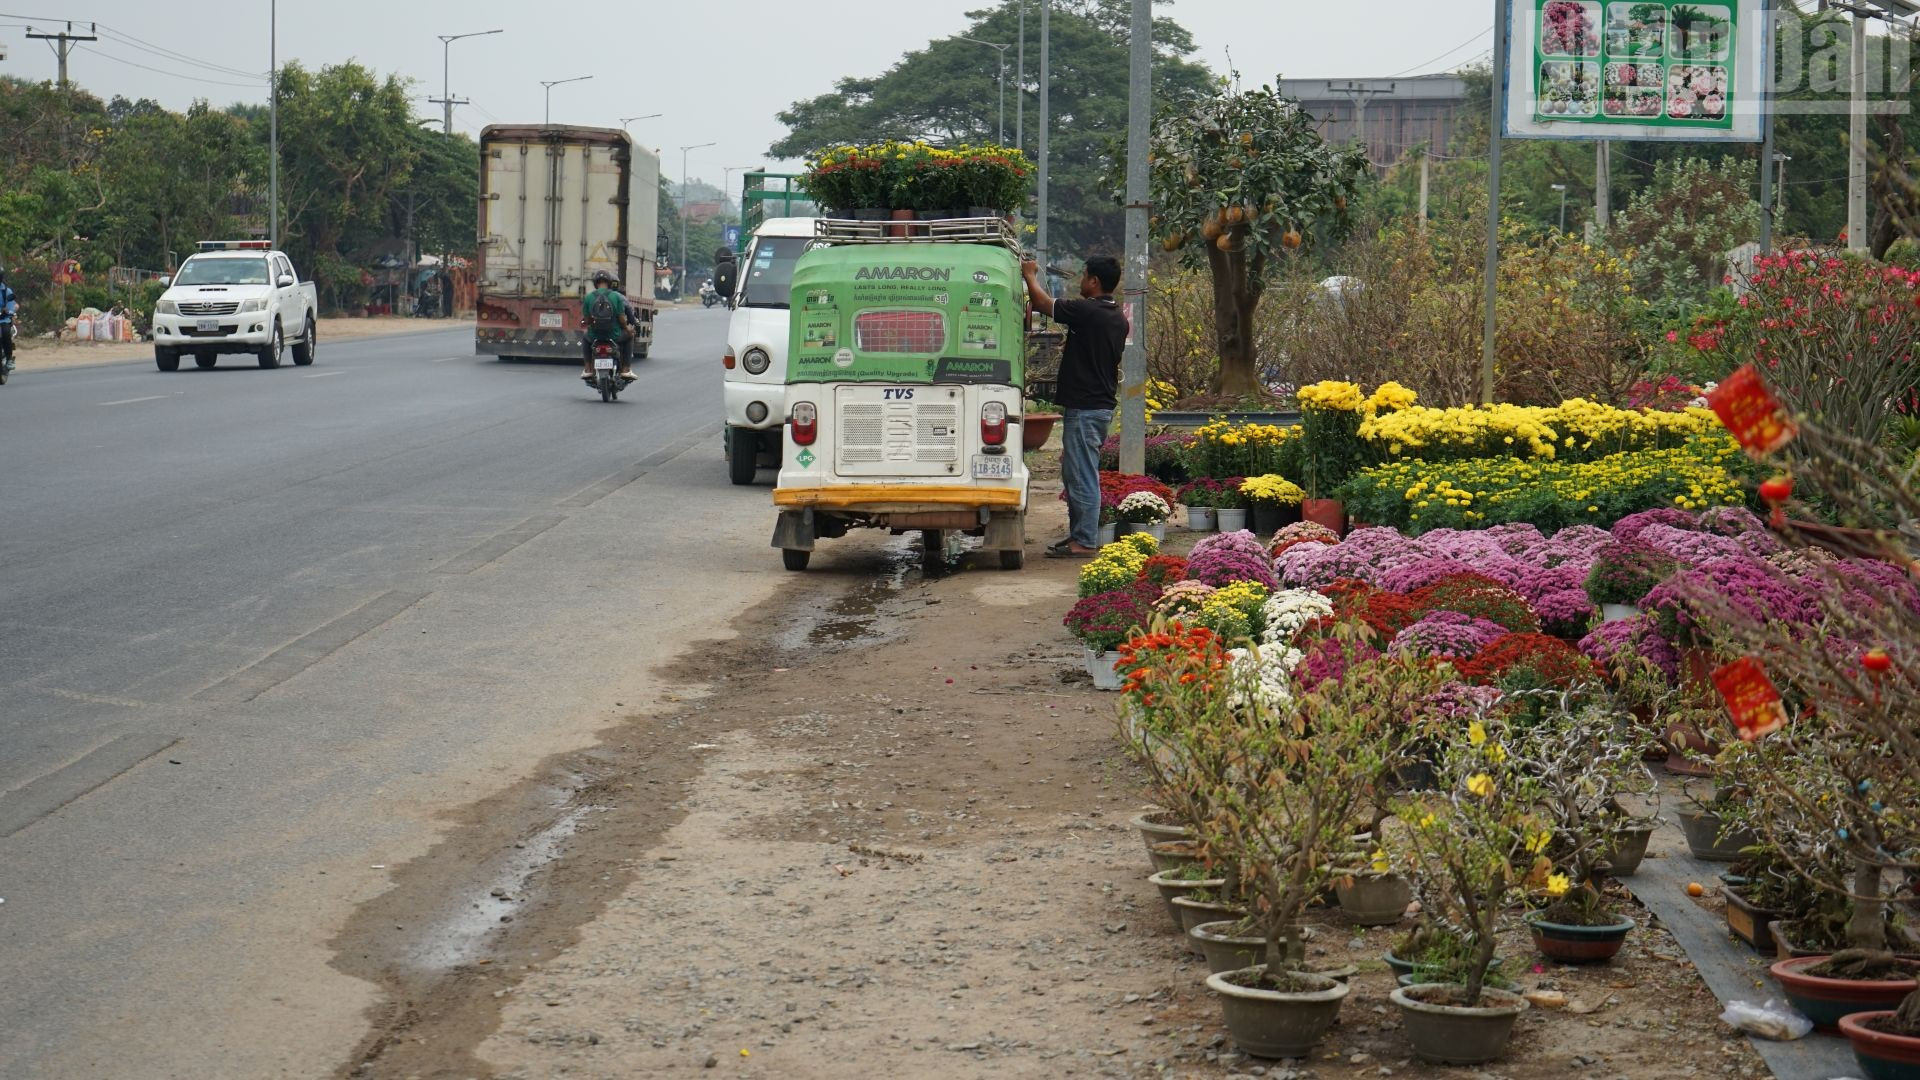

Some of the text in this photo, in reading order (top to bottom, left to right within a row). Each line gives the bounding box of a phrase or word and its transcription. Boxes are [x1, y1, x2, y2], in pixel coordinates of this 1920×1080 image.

[855, 266, 950, 281] AMARON
[798, 356, 832, 364] AMARON
[946, 361, 994, 372] AMARON
[857, 369, 885, 377] (Quality
[886, 370, 918, 378] Upgrade)
[883, 388, 914, 399] TVS
